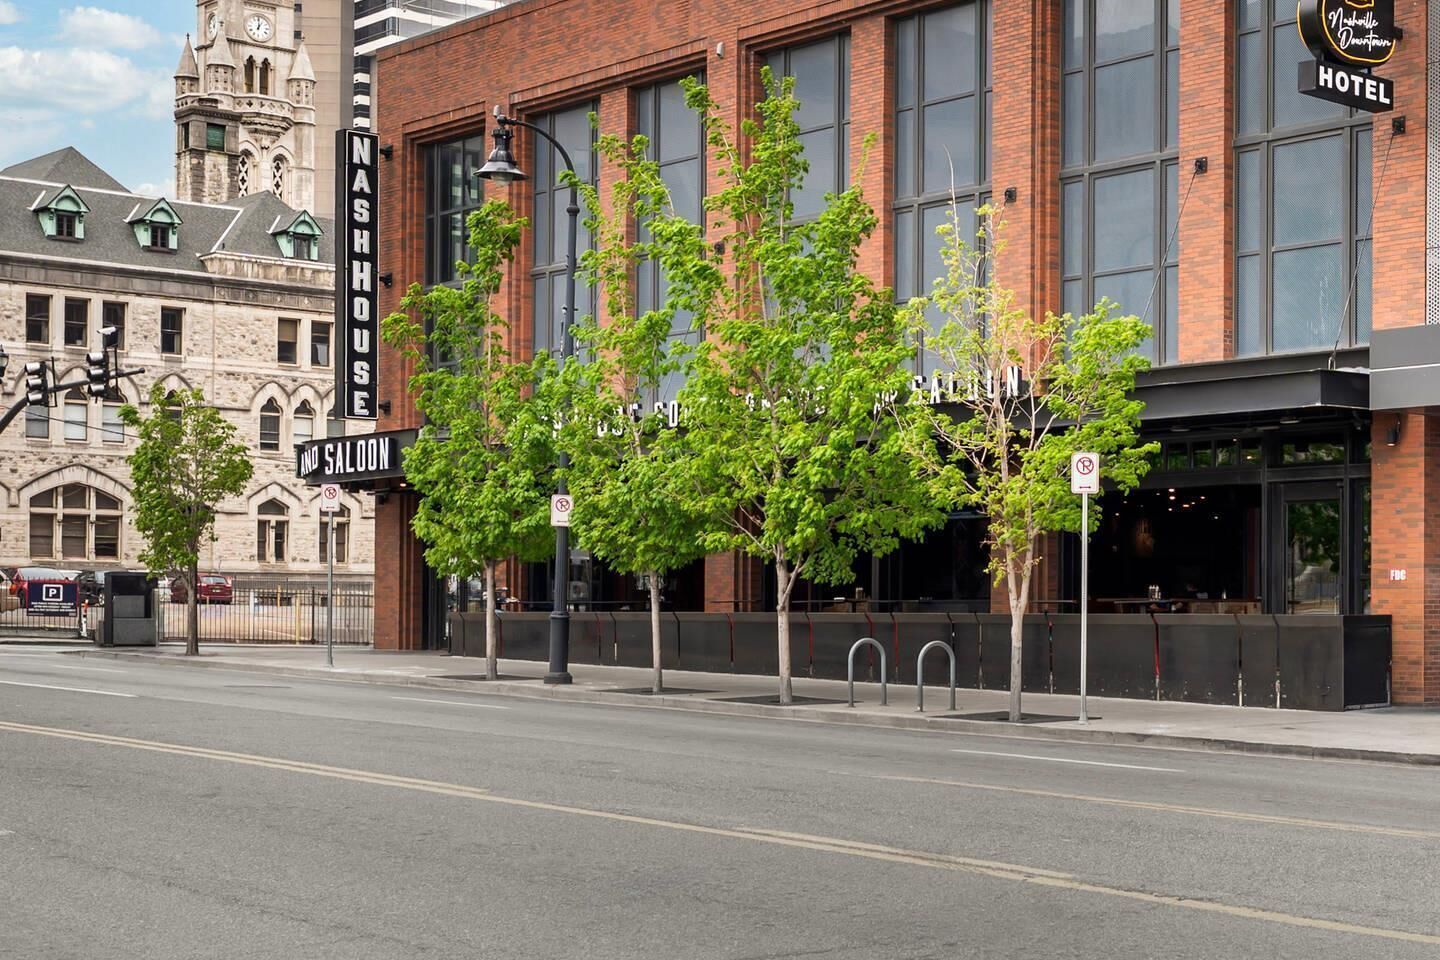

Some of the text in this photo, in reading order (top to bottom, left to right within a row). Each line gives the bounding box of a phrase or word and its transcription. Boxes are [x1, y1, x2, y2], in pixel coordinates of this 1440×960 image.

[1328, 7, 1379, 29] Nashville
[1338, 26, 1392, 52] Downtown
[1319, 65, 1391, 105] HOTEL
[300, 437, 390, 477] AND SALOON
